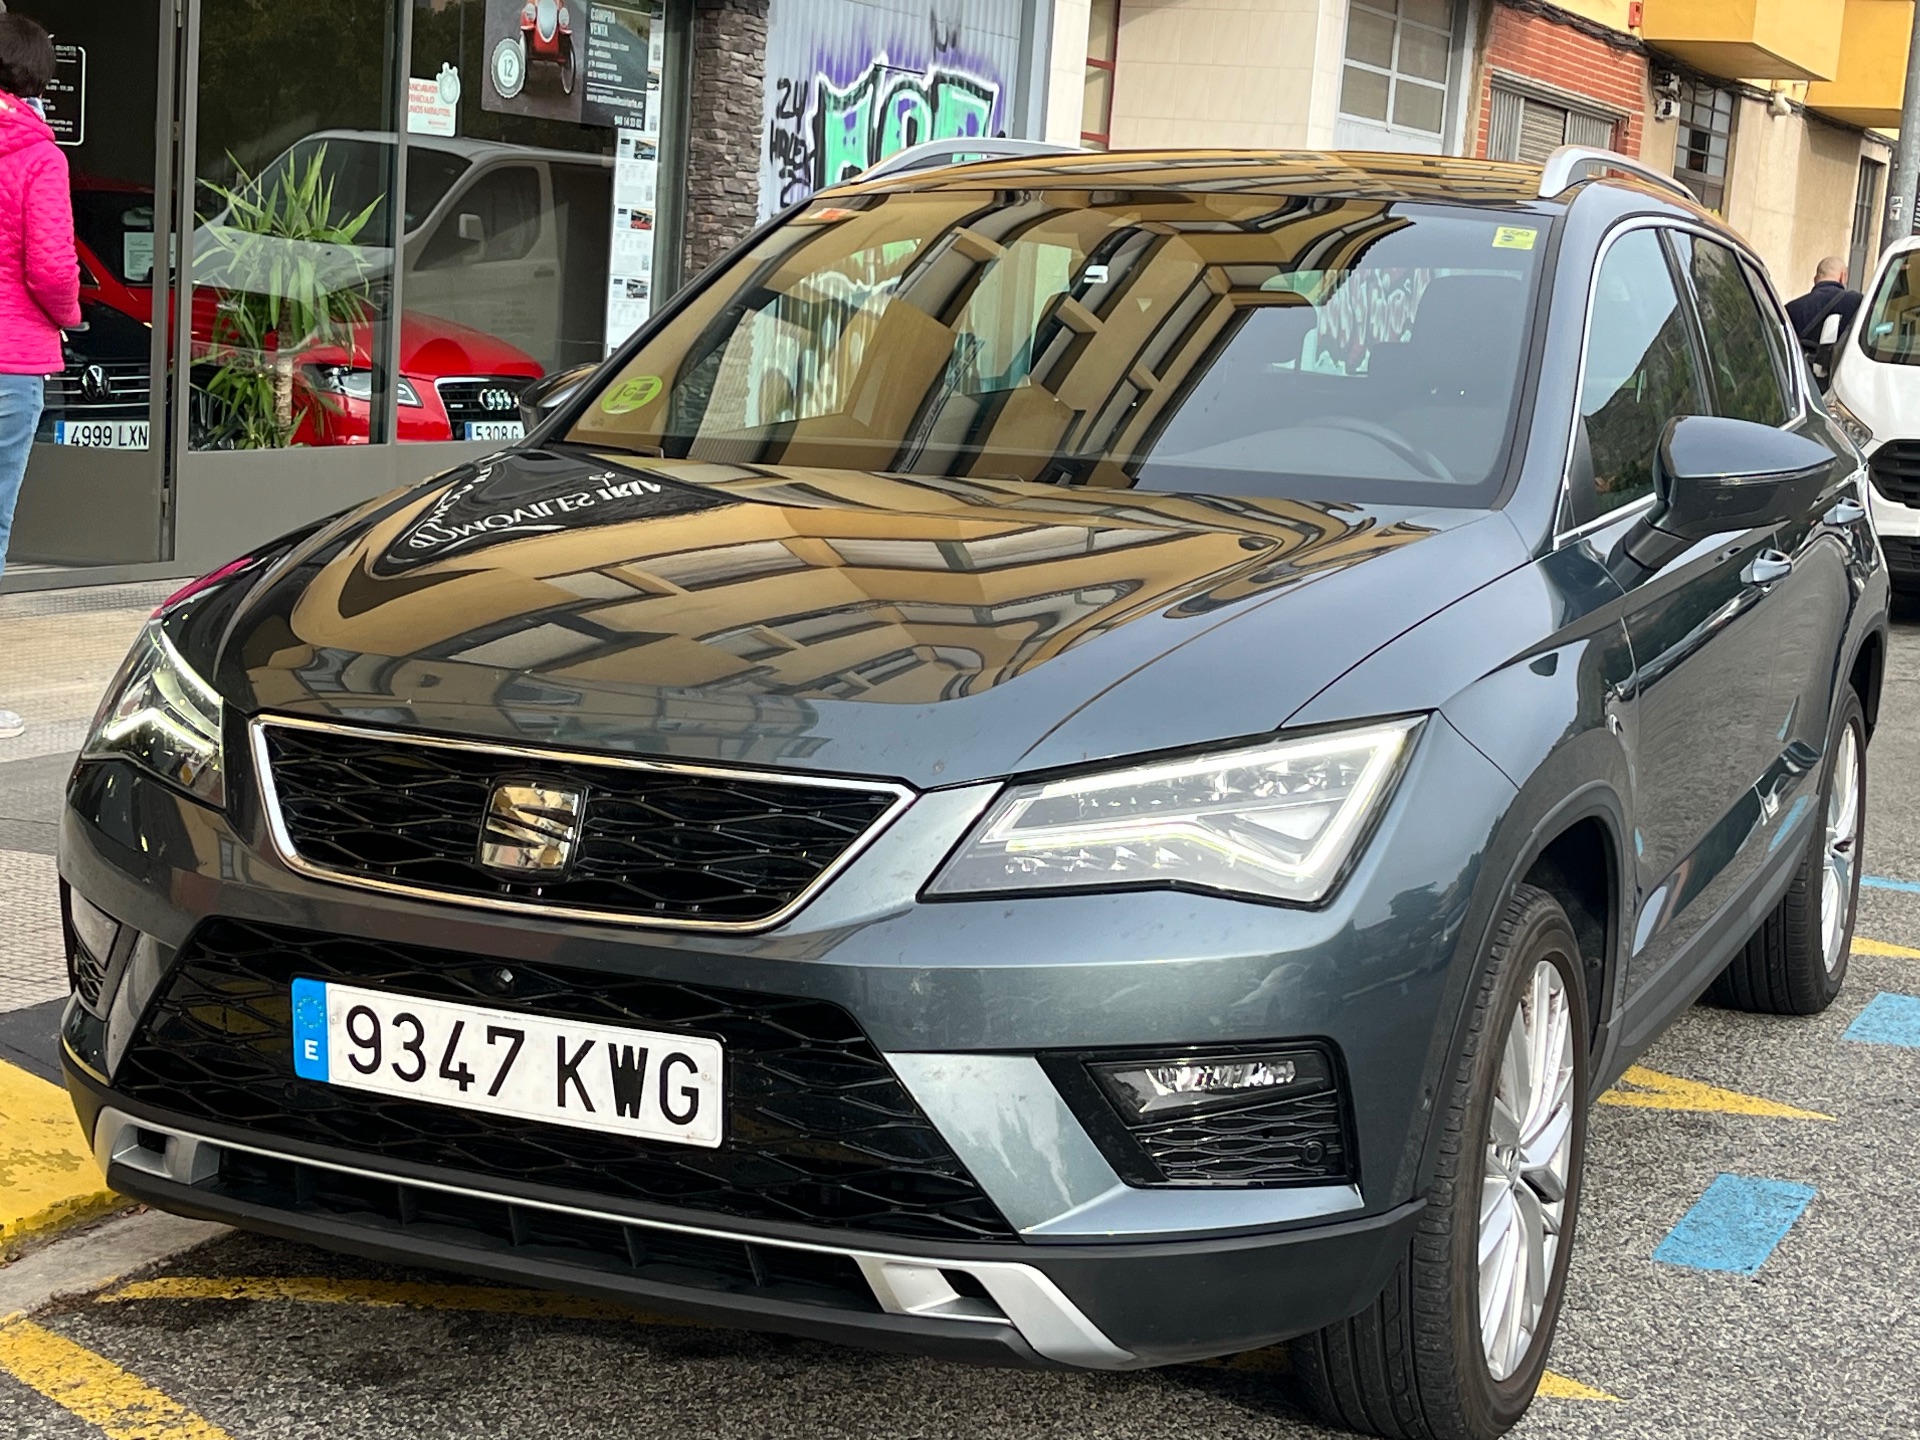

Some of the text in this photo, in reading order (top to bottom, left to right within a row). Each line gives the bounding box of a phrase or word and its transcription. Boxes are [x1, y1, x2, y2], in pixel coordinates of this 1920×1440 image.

[591, 9, 615, 24] COMPRA
[590, 23, 608, 36] VENTA
[504, 59, 513, 77] 12
[70, 425, 148, 447] 4999 LXN
[475, 425, 508, 441] 5308
[304, 1004, 701, 1126] E 9347 KWG
